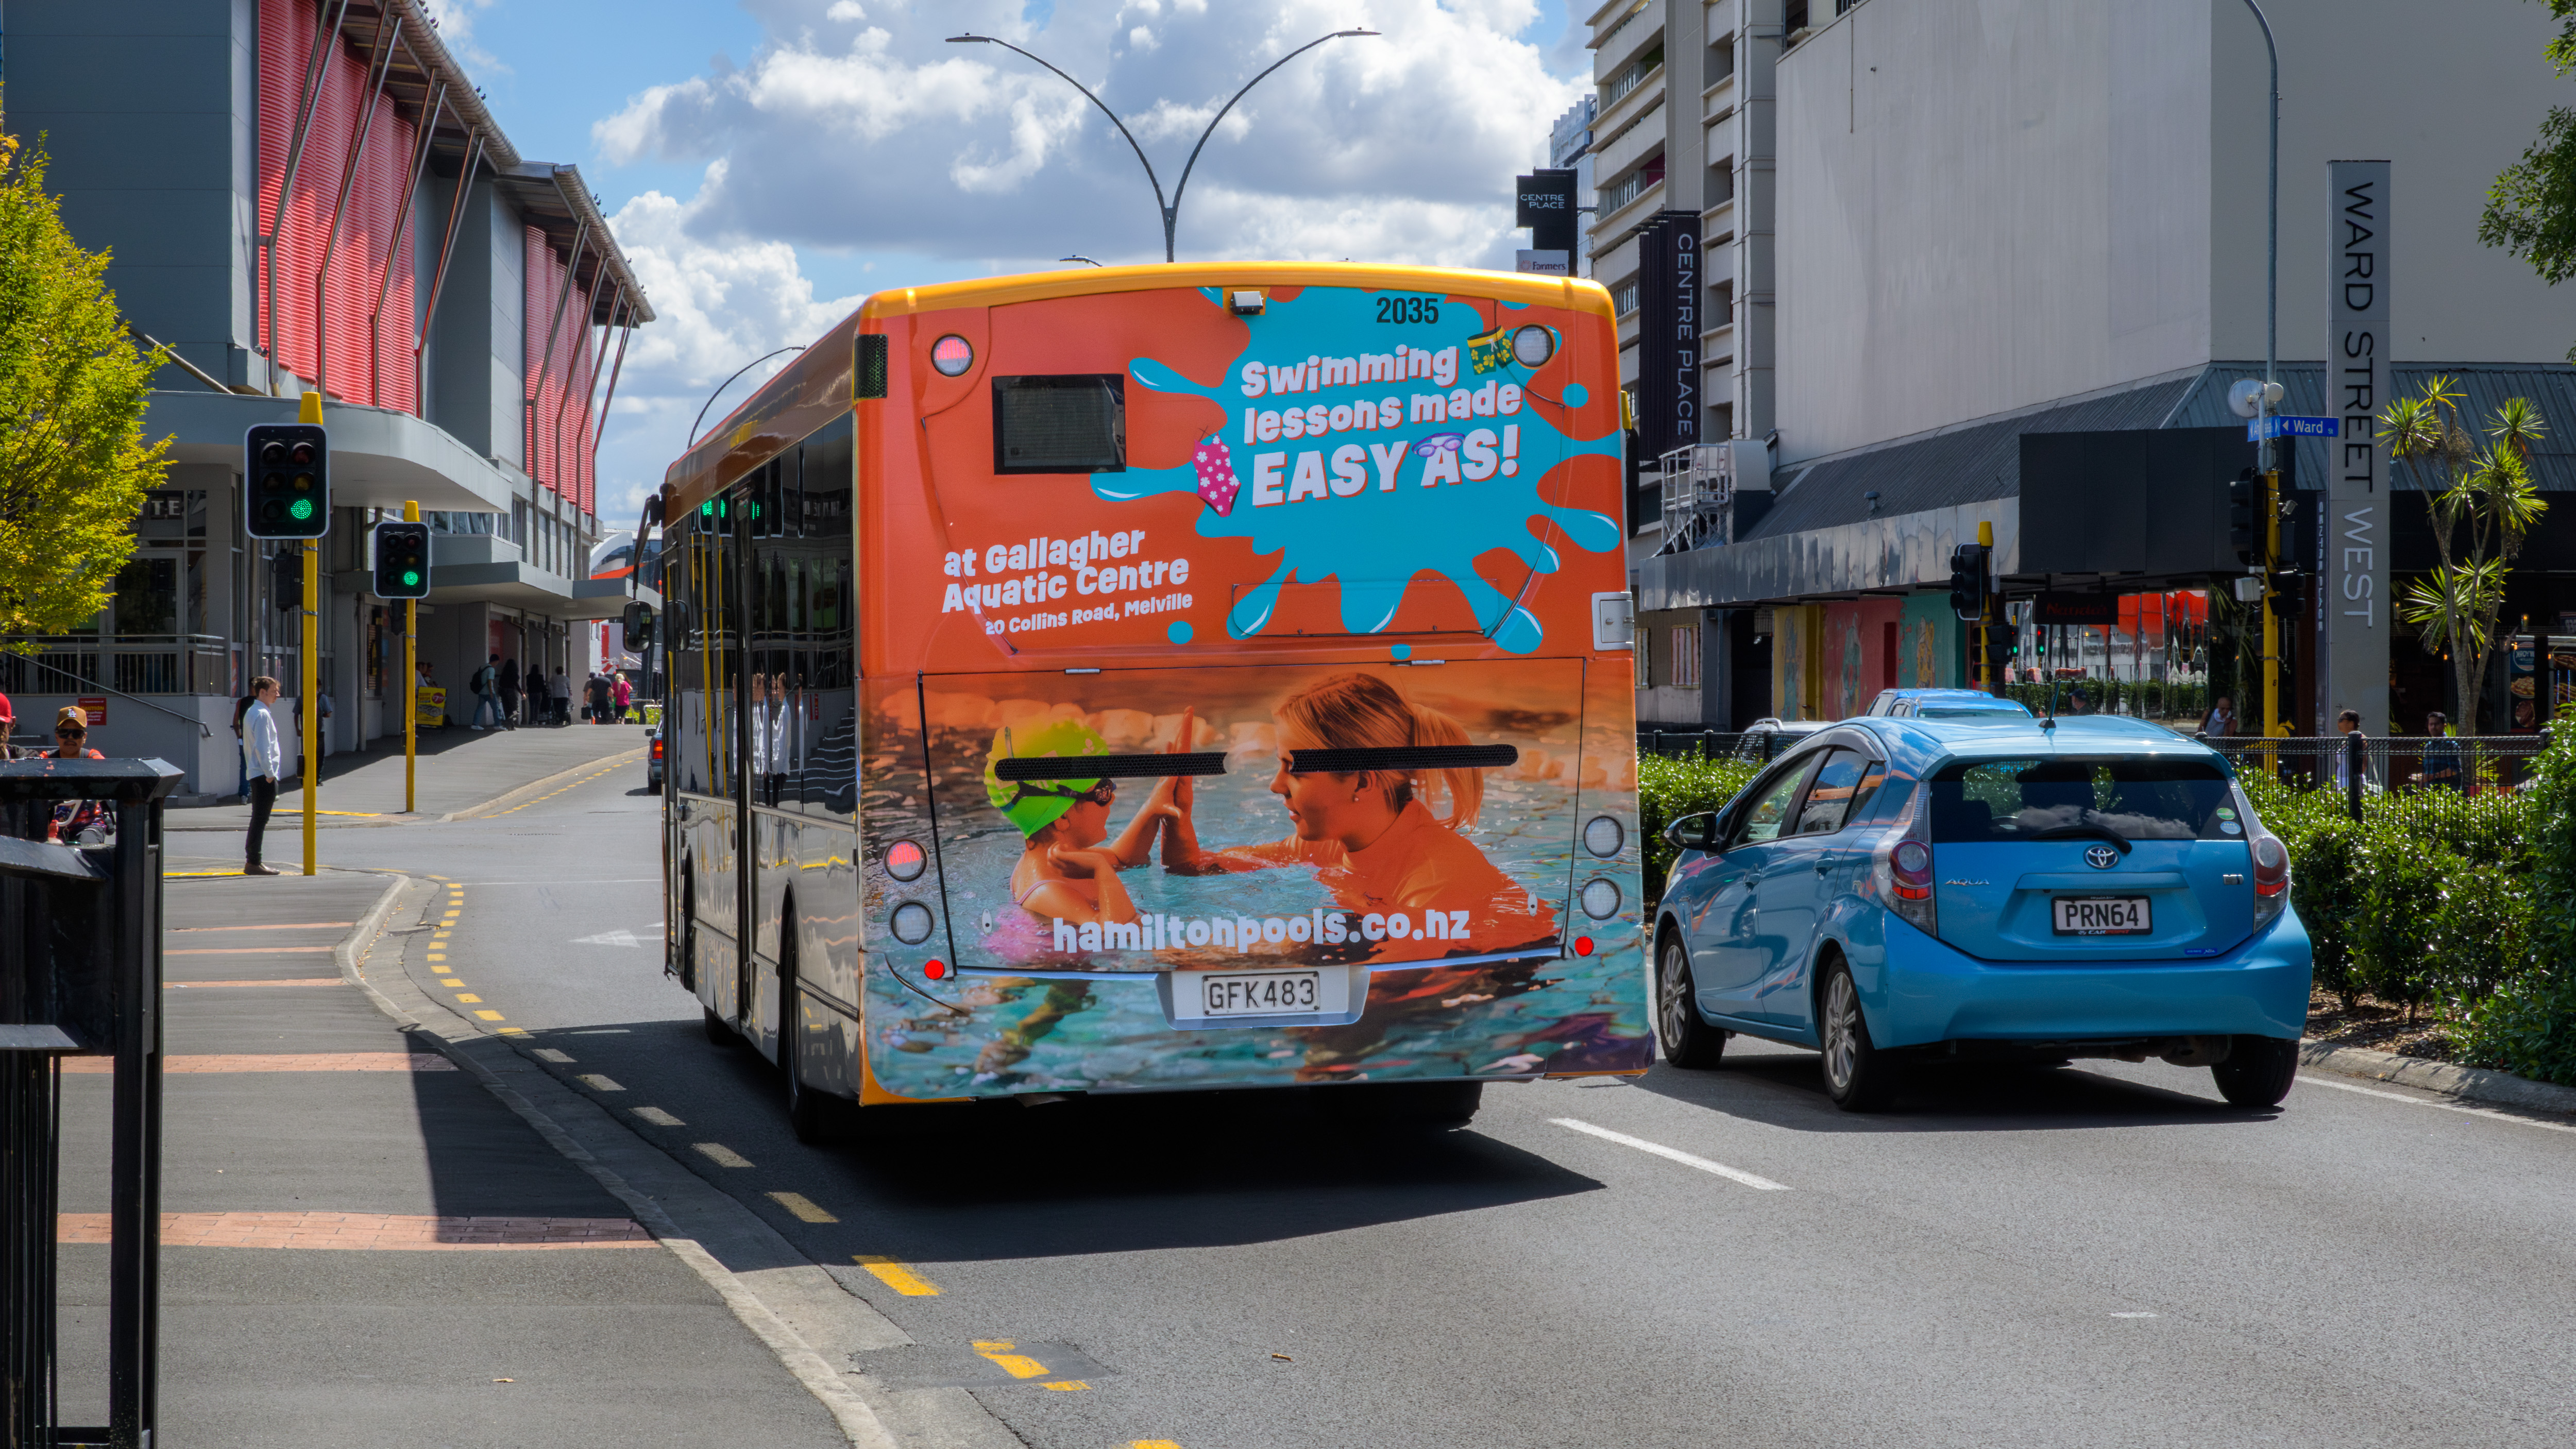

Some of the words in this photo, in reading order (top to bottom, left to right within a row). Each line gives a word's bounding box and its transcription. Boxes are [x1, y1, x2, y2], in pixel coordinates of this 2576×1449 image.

[1533, 262, 1566, 270] Farmers
[2345, 182, 2373, 311] WARD
[1376, 297, 1439, 325] 2035
[1677, 233, 1693, 340] CENTRE
[1241, 344, 1459, 398] Swimming
[1677, 350, 1693, 435] PLACE
[1243, 397, 1402, 445] lessons
[1410, 380, 1522, 422] made
[2294, 420, 2323, 433] Ward
[2345, 331, 2373, 493] STREET
[1252, 440, 1409, 508] EASY
[1419, 424, 1521, 487] AS!
[944, 548, 977, 577] at
[985, 530, 1145, 573] Gallagher
[2344, 507, 2373, 628] WEST
[942, 571, 1067, 614] Aquatic
[1076, 558, 1189, 595] Centre
[985, 619, 1005, 635] 20
[1009, 609, 1068, 634] Collins
[1072, 603, 1120, 625] Road,
[1124, 593, 1193, 617] Melville
[1945, 878, 1990, 887] AQUA
[1053, 907, 1471, 953] hamiltonpools.co.nz
[2065, 904, 2139, 927] PRN64
[1210, 979, 1314, 1009] GFK483
